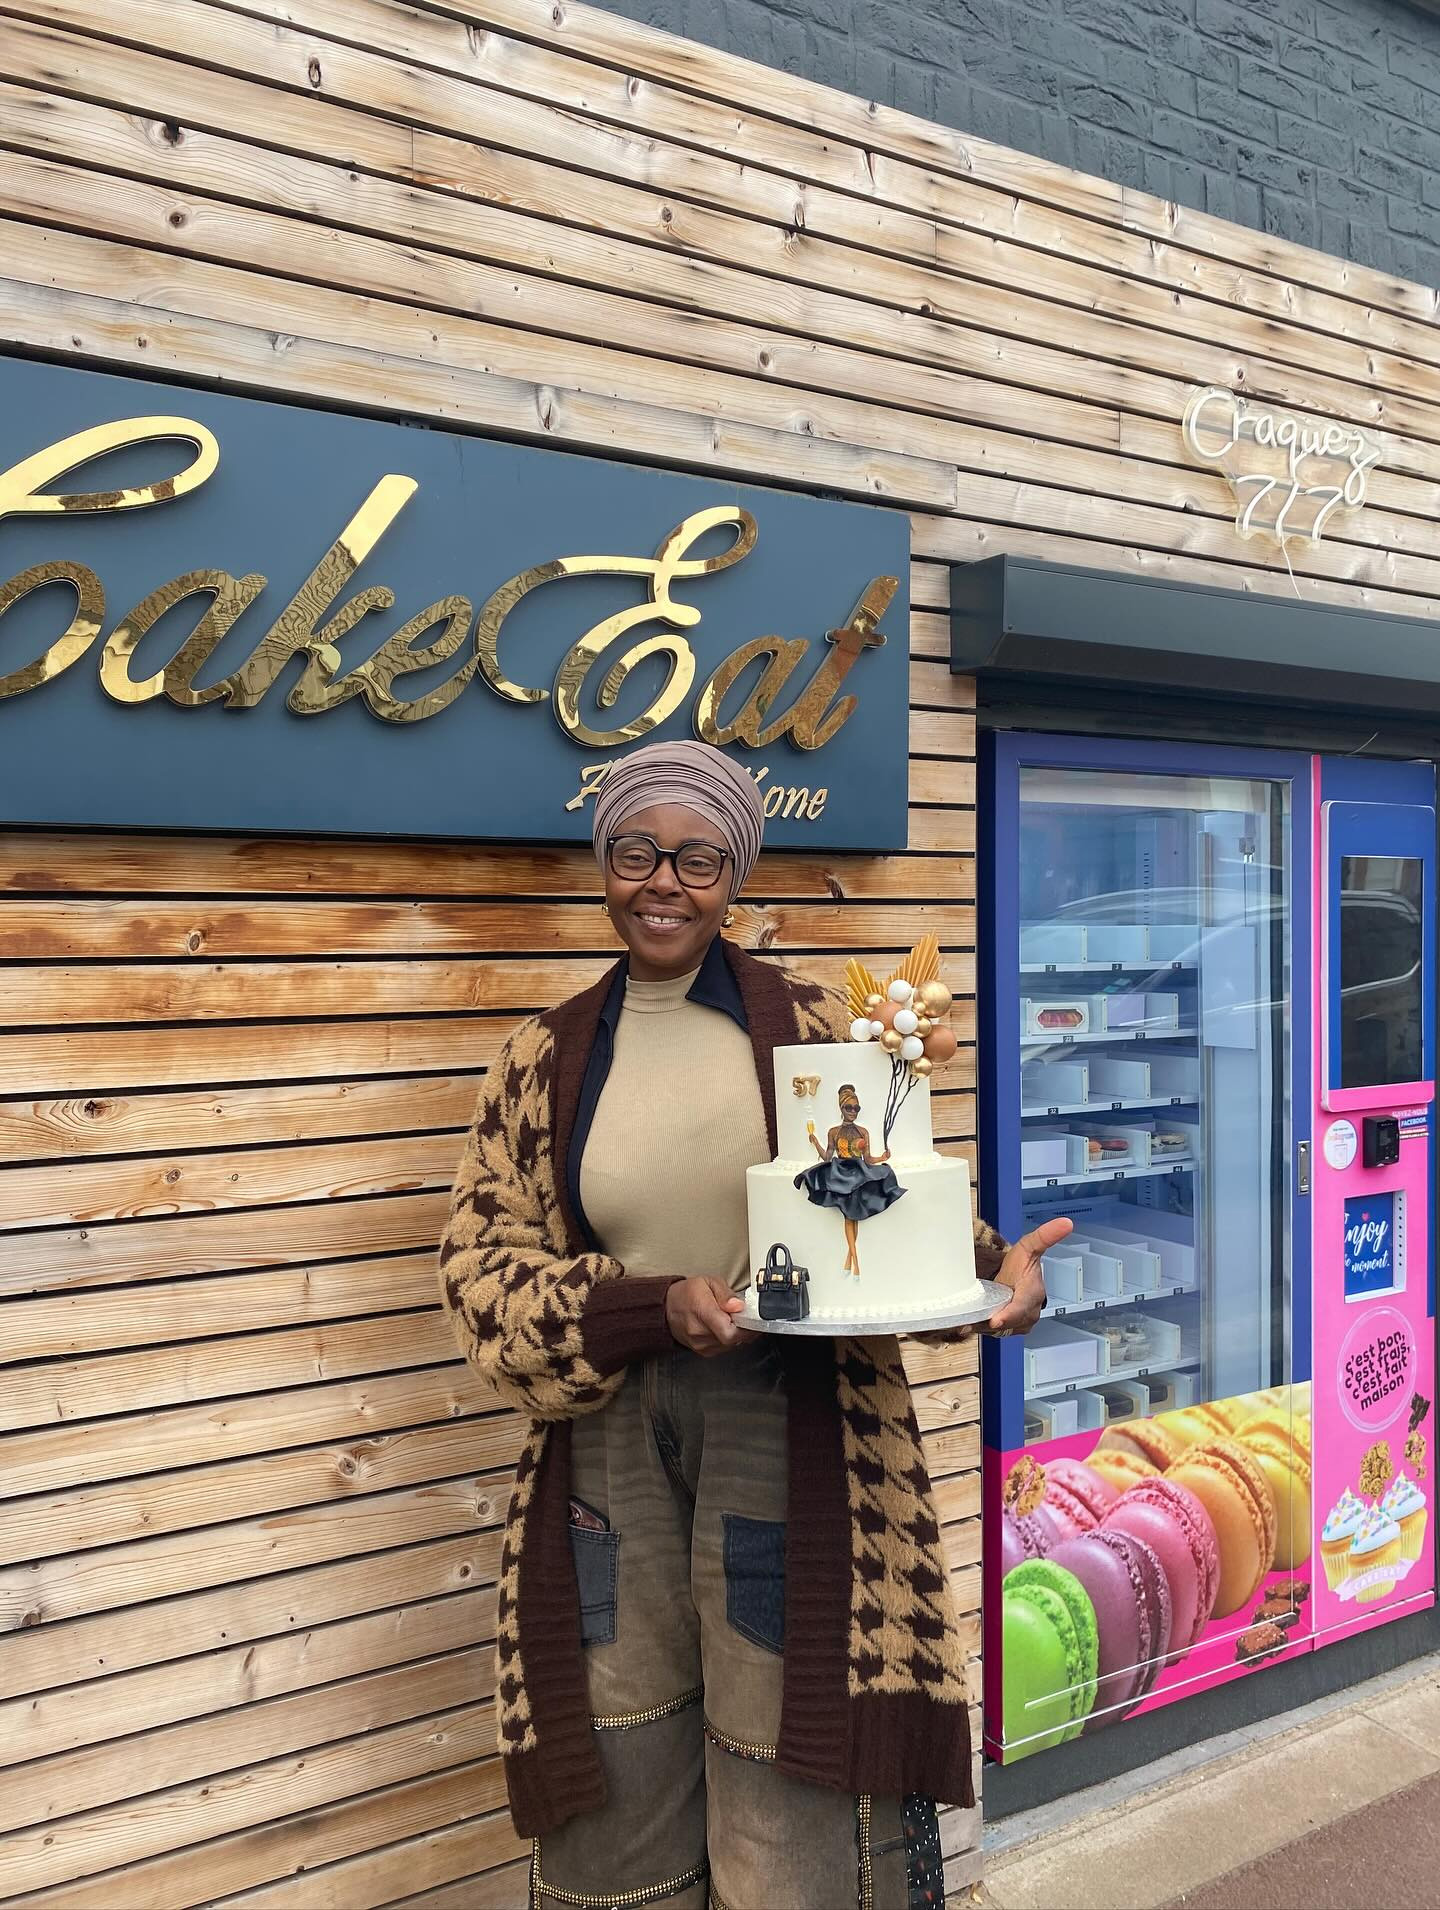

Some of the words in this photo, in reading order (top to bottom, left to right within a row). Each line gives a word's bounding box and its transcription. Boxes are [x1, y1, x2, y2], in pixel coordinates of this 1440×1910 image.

[1189, 391, 1381, 505] Craquez
[792, 1076, 821, 1098] 57
[1400, 1116, 1427, 1127] FACEBOOK
[1345, 1344, 1375, 1374] c'est
[1377, 1331, 1405, 1353] bon,
[1360, 1374, 1404, 1411] maison
